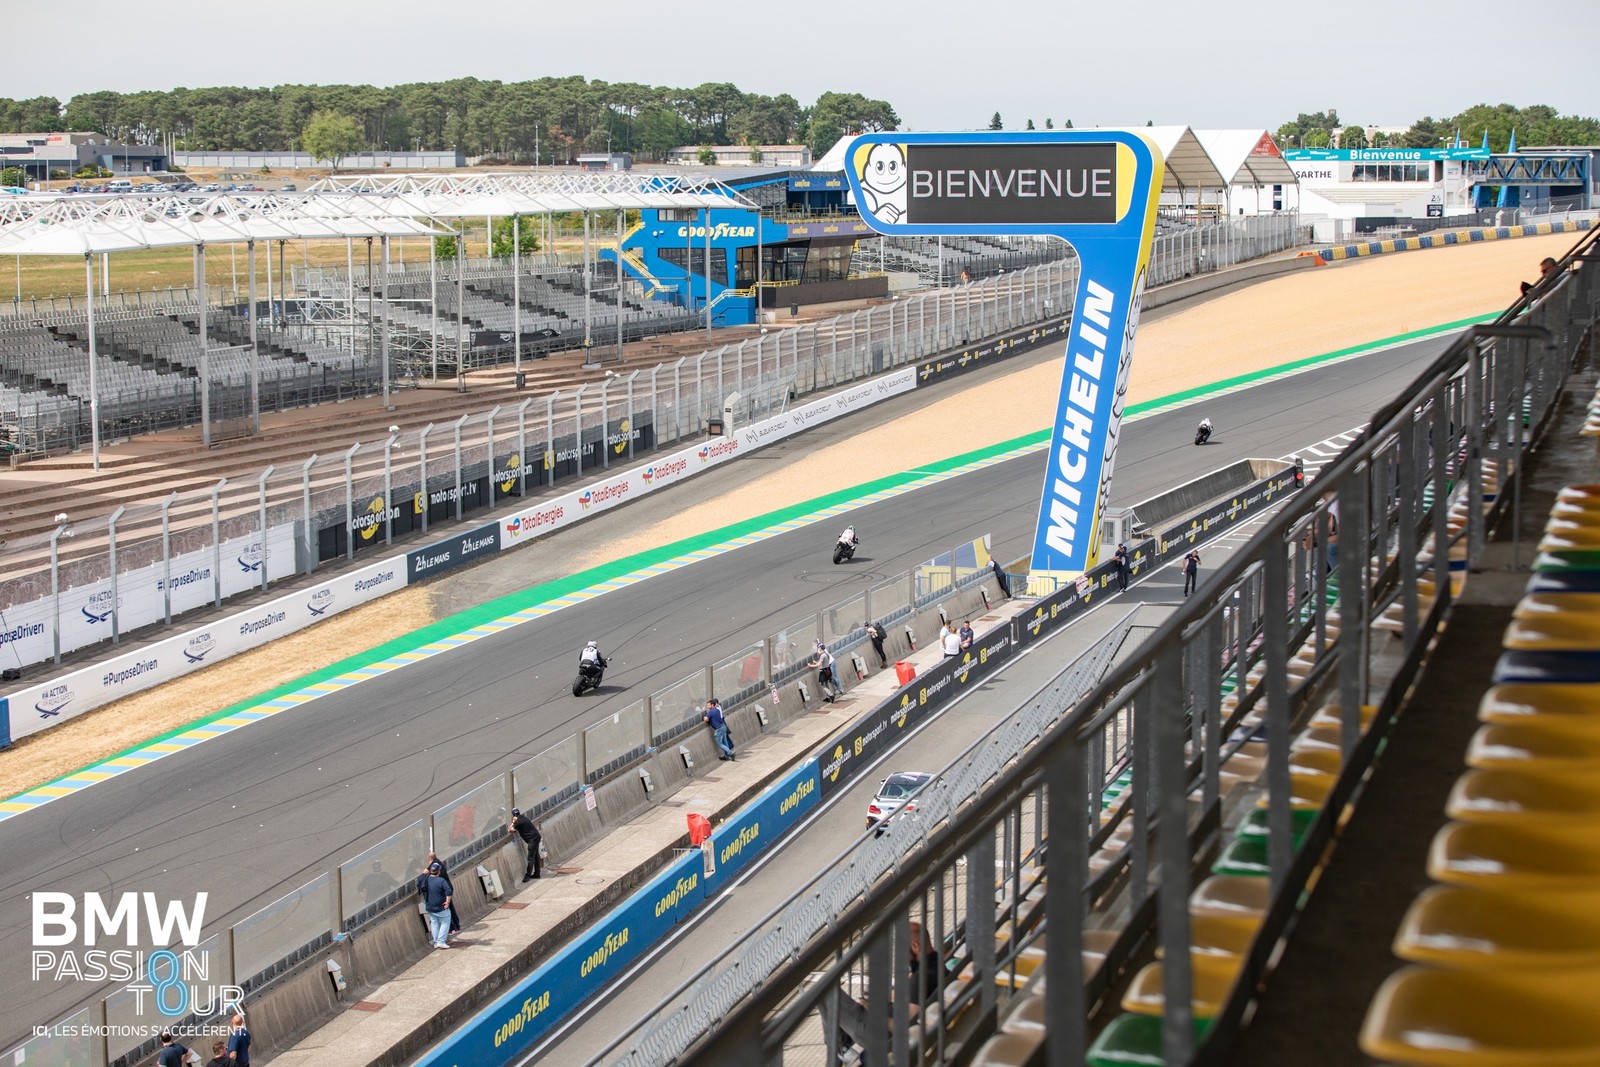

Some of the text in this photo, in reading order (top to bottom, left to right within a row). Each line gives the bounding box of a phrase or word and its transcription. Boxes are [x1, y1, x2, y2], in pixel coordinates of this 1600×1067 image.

[1350, 150, 1421, 160] Bienvenue
[912, 169, 1112, 198] BIENVENUE
[1046, 279, 1114, 558] MICHELIN
[654, 458, 686, 480] TotalEnergies
[431, 482, 477, 505] motorsprt.tv
[592, 480, 628, 504] TotalEnergies
[522, 506, 564, 532] TotalEnergies
[480, 535, 494, 548] MANS
[434, 552, 450, 565] MANS
[158, 568, 210, 591] #urposeDriven
[355, 570, 394, 592] #PurposeDriven
[240, 611, 285, 635] #PurposeDriven
[196, 632, 210, 645] ACTION
[987, 637, 1009, 657] motorsport.tv
[103, 659, 158, 687] #PurposeDriven
[954, 657, 978, 679] motorsport.com
[50, 684, 67, 697] ACTION
[926, 674, 951, 698] motorsport.tv
[890, 699, 916, 724] motorsport.com
[862, 720, 887, 747] motorsport.tv
[823, 749, 851, 779] motorsport.com
[780, 778, 814, 815] GOODYEAR
[721, 822, 759, 864] GOODYEAR
[655, 873, 697, 917] GOODYEAR
[581, 928, 629, 977] GOODYEAR
[494, 990, 550, 1048] GOODYEAR
